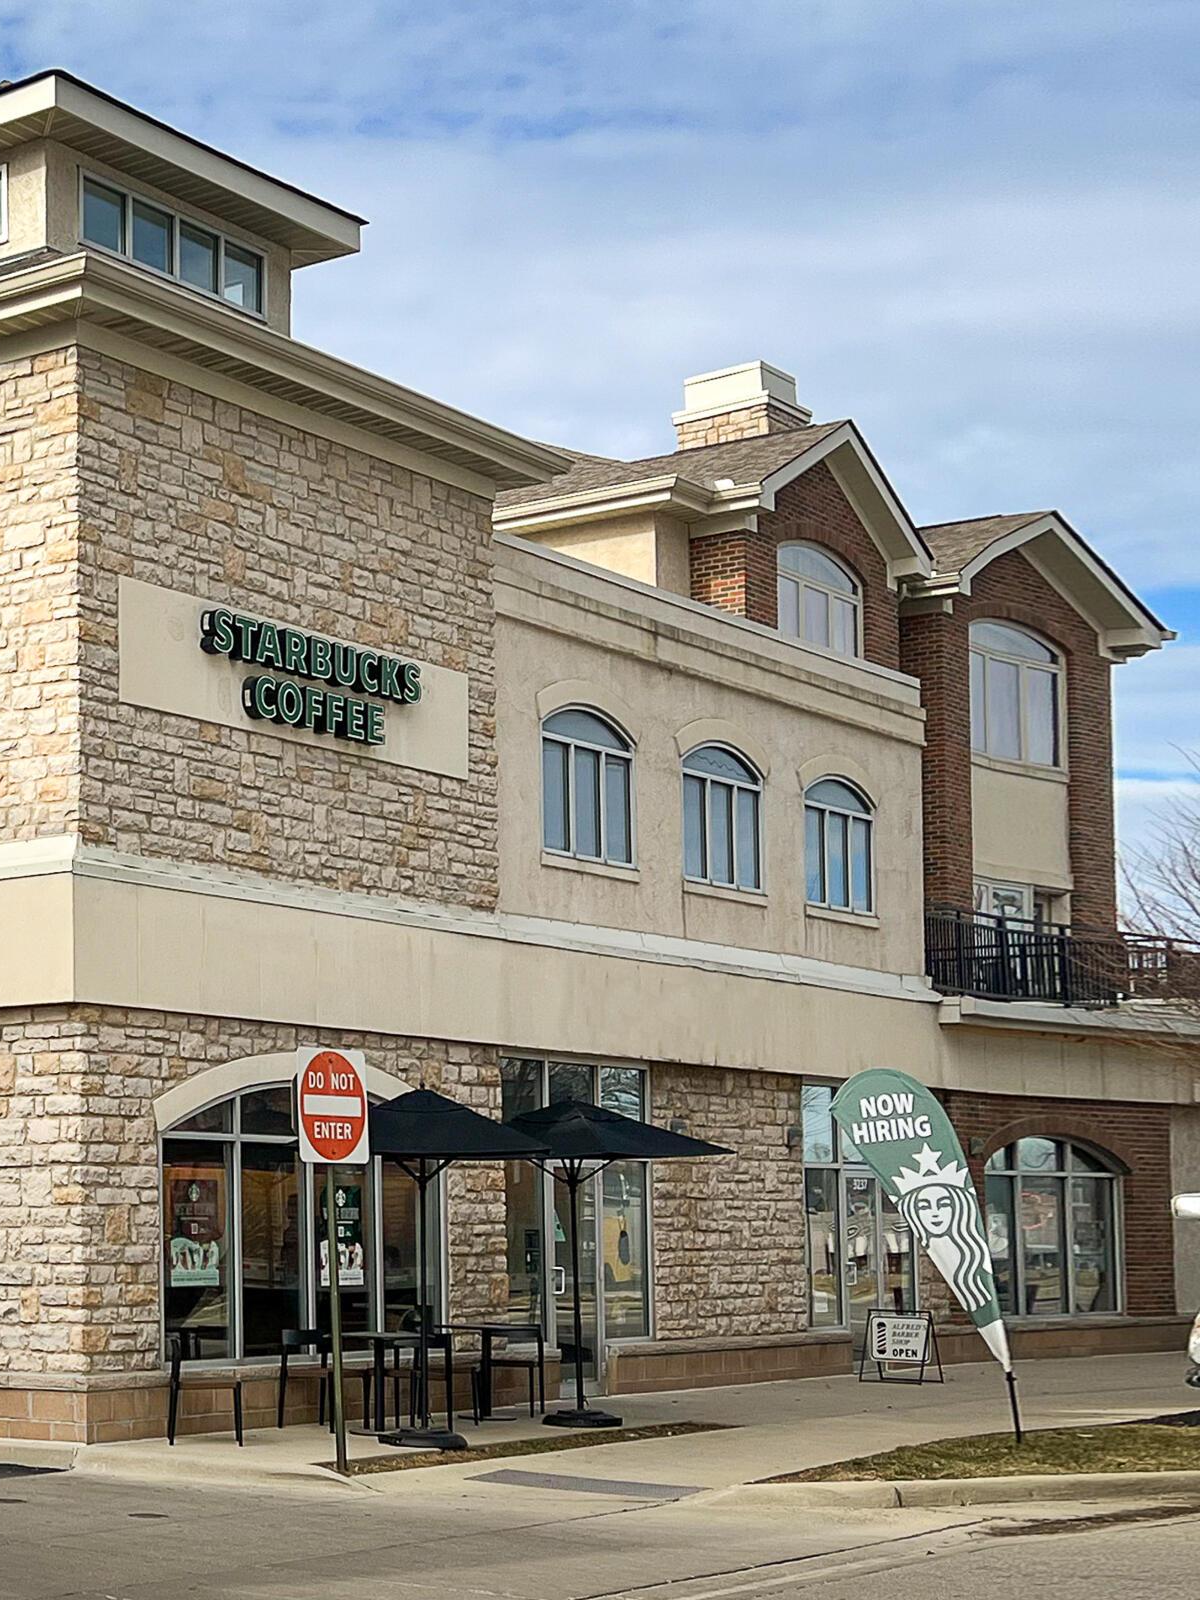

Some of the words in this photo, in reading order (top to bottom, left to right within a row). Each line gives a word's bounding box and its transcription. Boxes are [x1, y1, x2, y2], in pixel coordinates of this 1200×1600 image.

[211, 608, 422, 704] STARBUCKS
[254, 675, 386, 745] COFFEE
[308, 1071, 325, 1089] DO
[331, 1073, 355, 1090] NOT
[859, 1093, 914, 1119] NOW
[313, 1121, 352, 1140] ENTER
[851, 1115, 932, 1145] HIRING
[892, 1348, 918, 1358] OPEN
